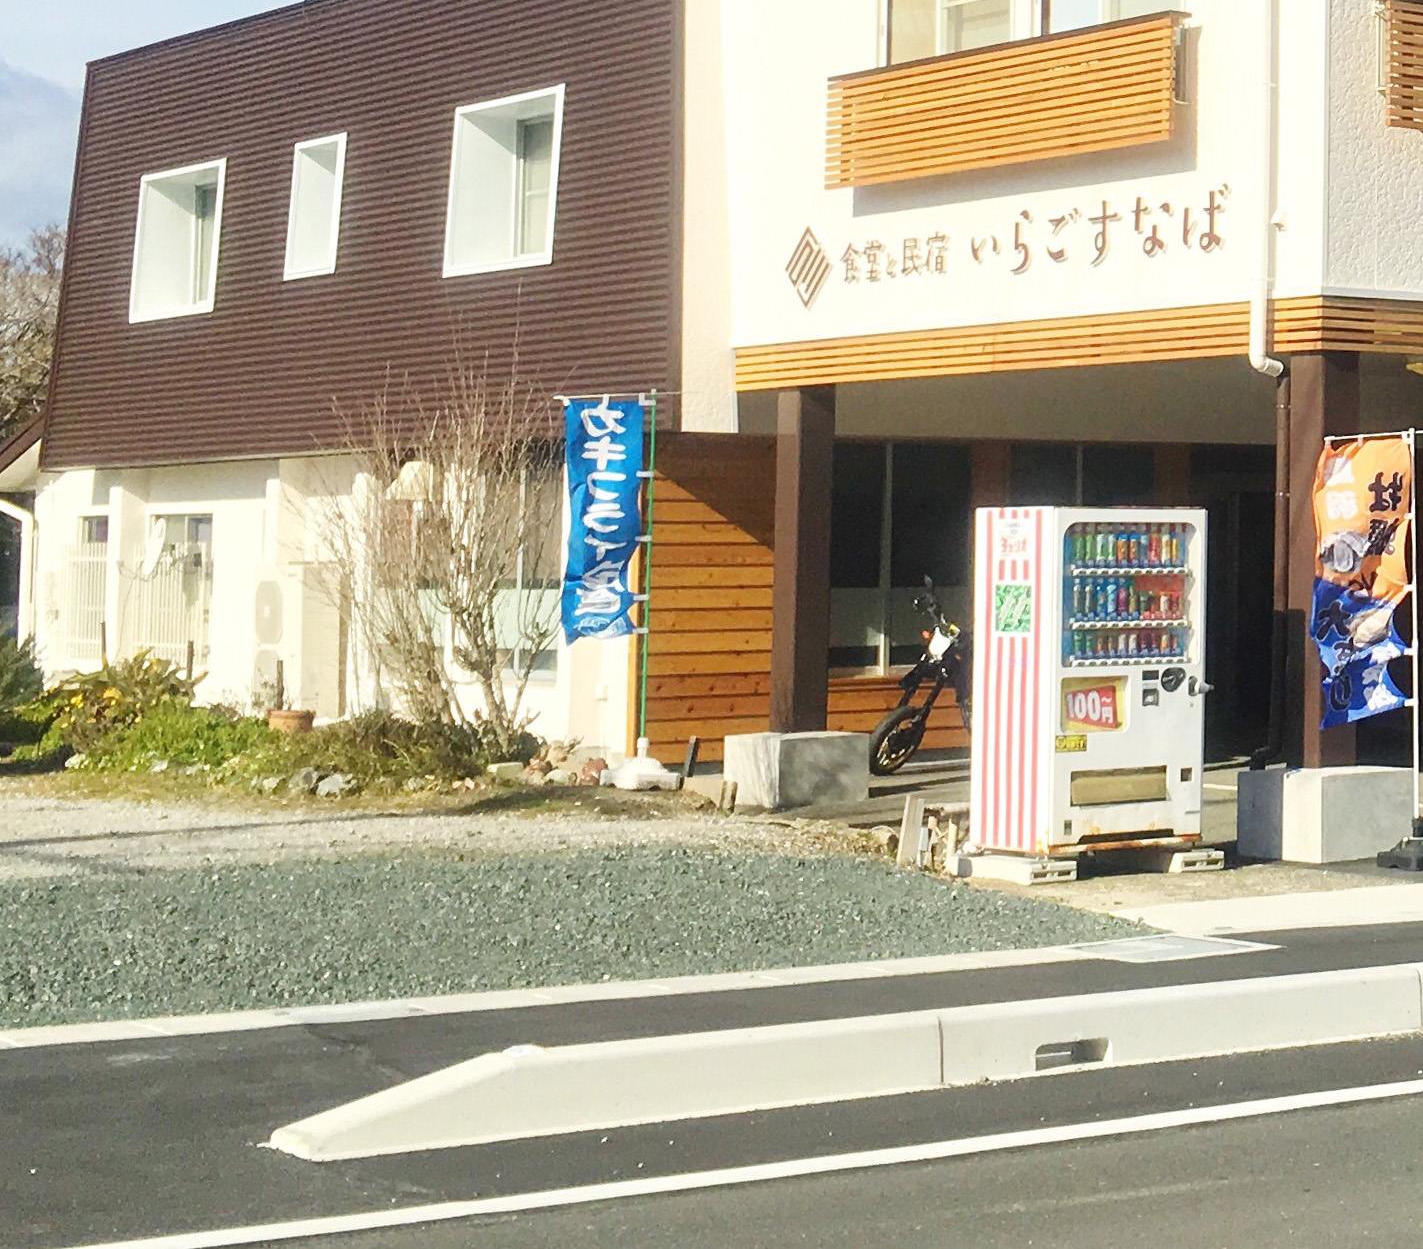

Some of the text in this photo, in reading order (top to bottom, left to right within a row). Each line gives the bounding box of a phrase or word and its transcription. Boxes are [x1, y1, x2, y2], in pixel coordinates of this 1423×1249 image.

[839, 182, 1234, 284] 食堂と民宿 いらごすなば
